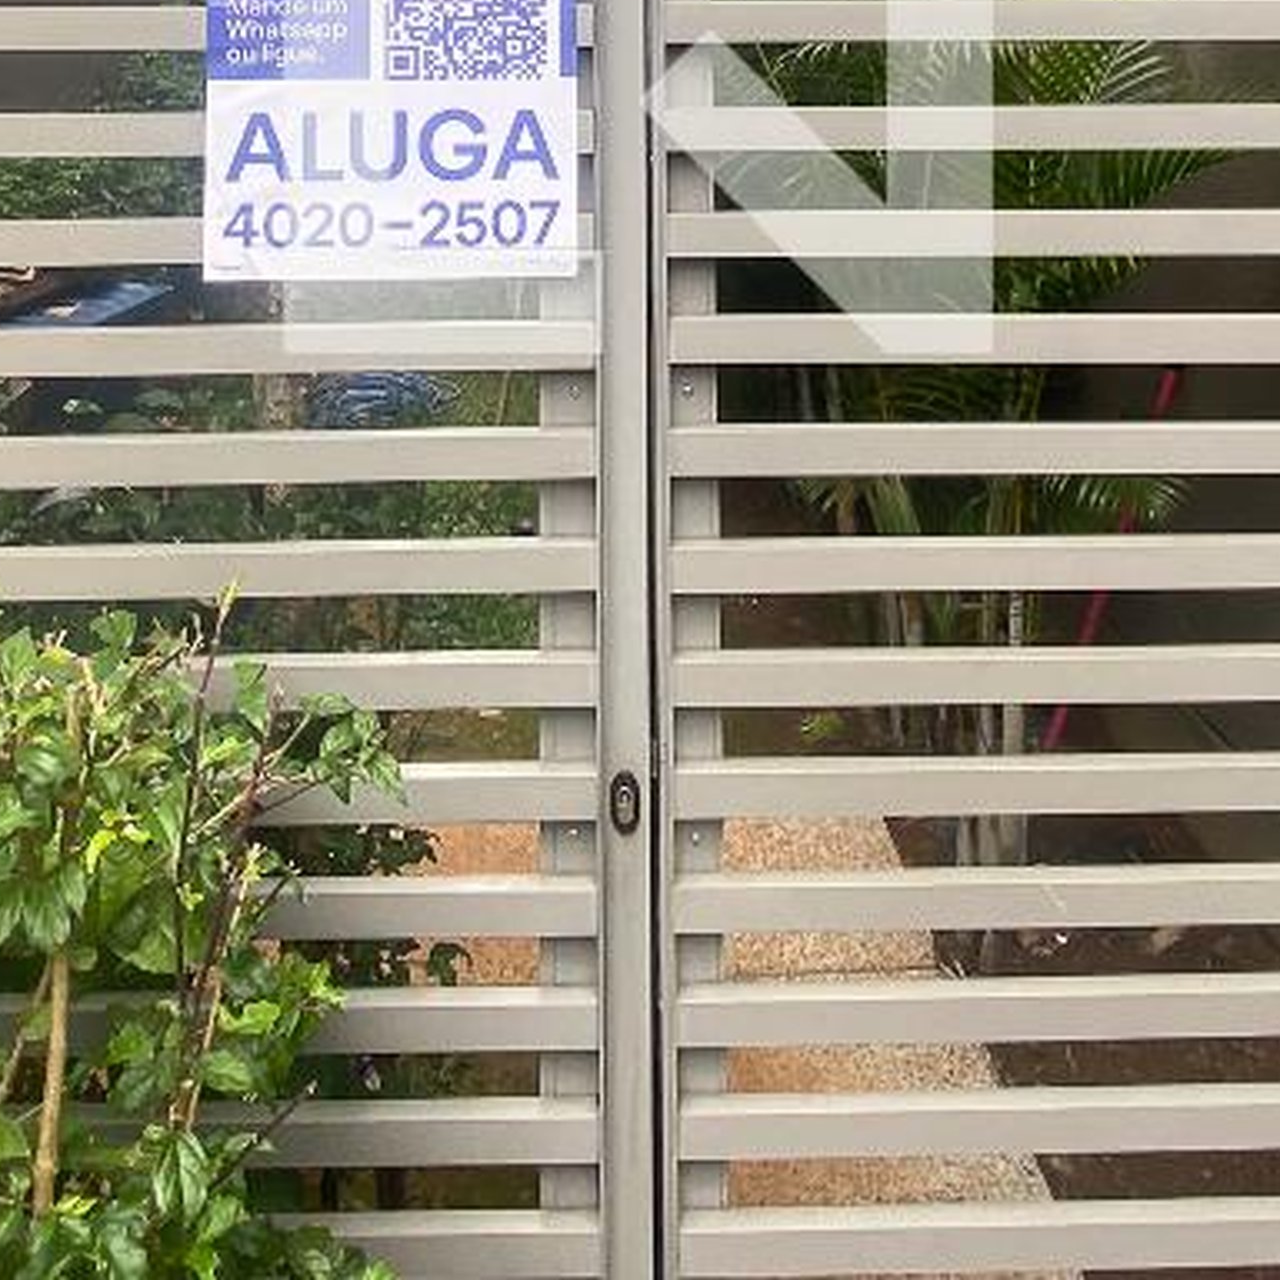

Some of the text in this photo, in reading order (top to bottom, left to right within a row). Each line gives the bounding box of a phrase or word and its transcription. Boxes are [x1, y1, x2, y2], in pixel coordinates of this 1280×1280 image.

[312, 0, 348, 14] um
[226, 48, 258, 64] ou
[224, 108, 561, 182] ALUGA
[222, 199, 561, 248] 4020-2507
